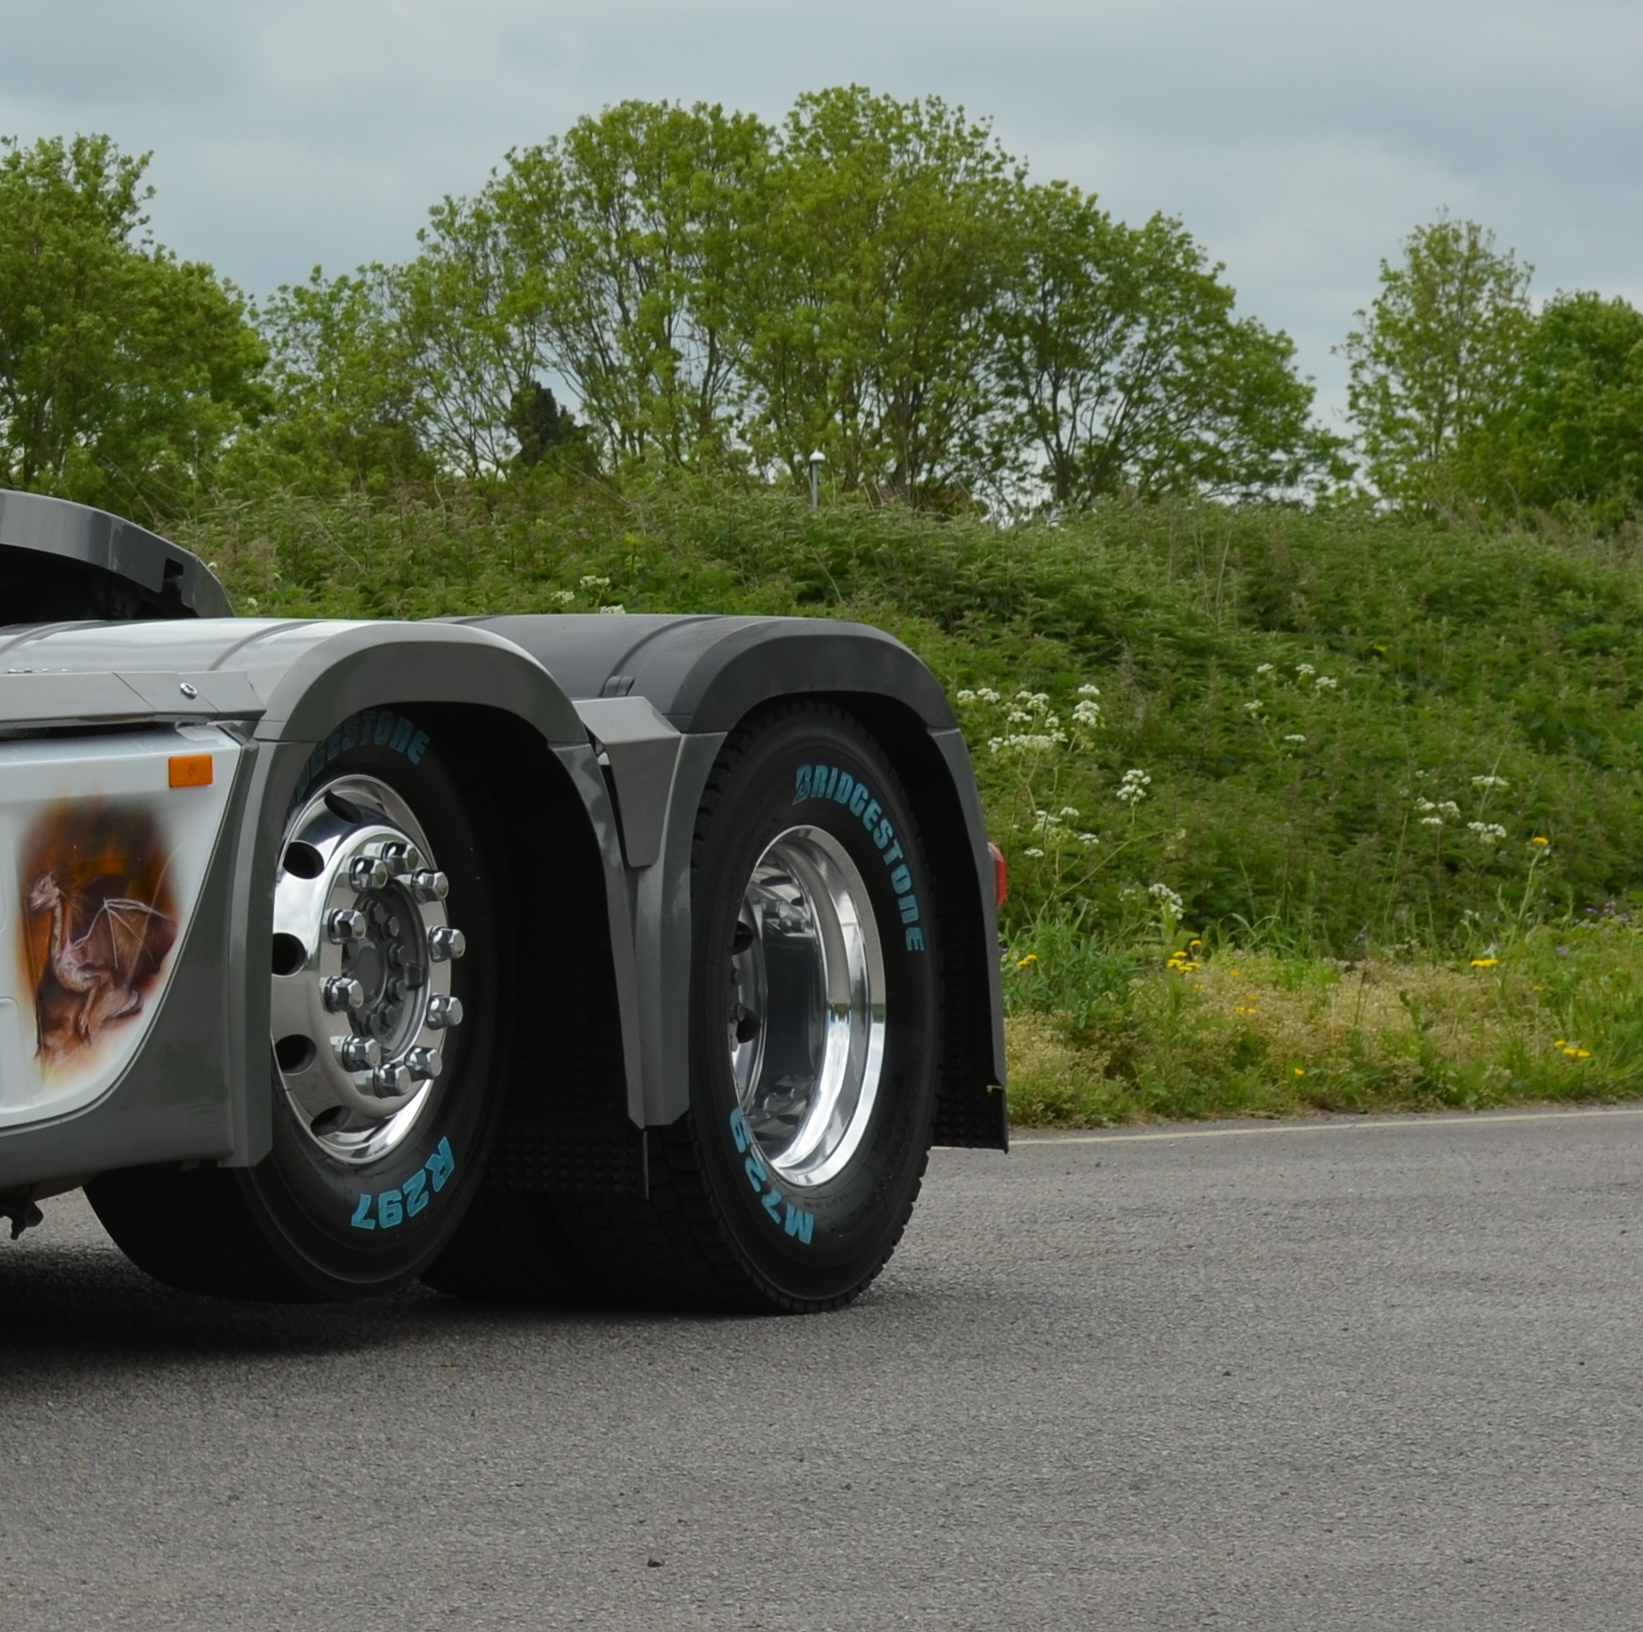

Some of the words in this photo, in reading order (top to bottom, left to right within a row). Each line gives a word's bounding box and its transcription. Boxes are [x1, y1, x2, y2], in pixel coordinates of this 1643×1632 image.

[792, 764, 924, 951] BRIDGESTONE
[351, 1136, 455, 1230] R297
[730, 1106, 814, 1245] M729
